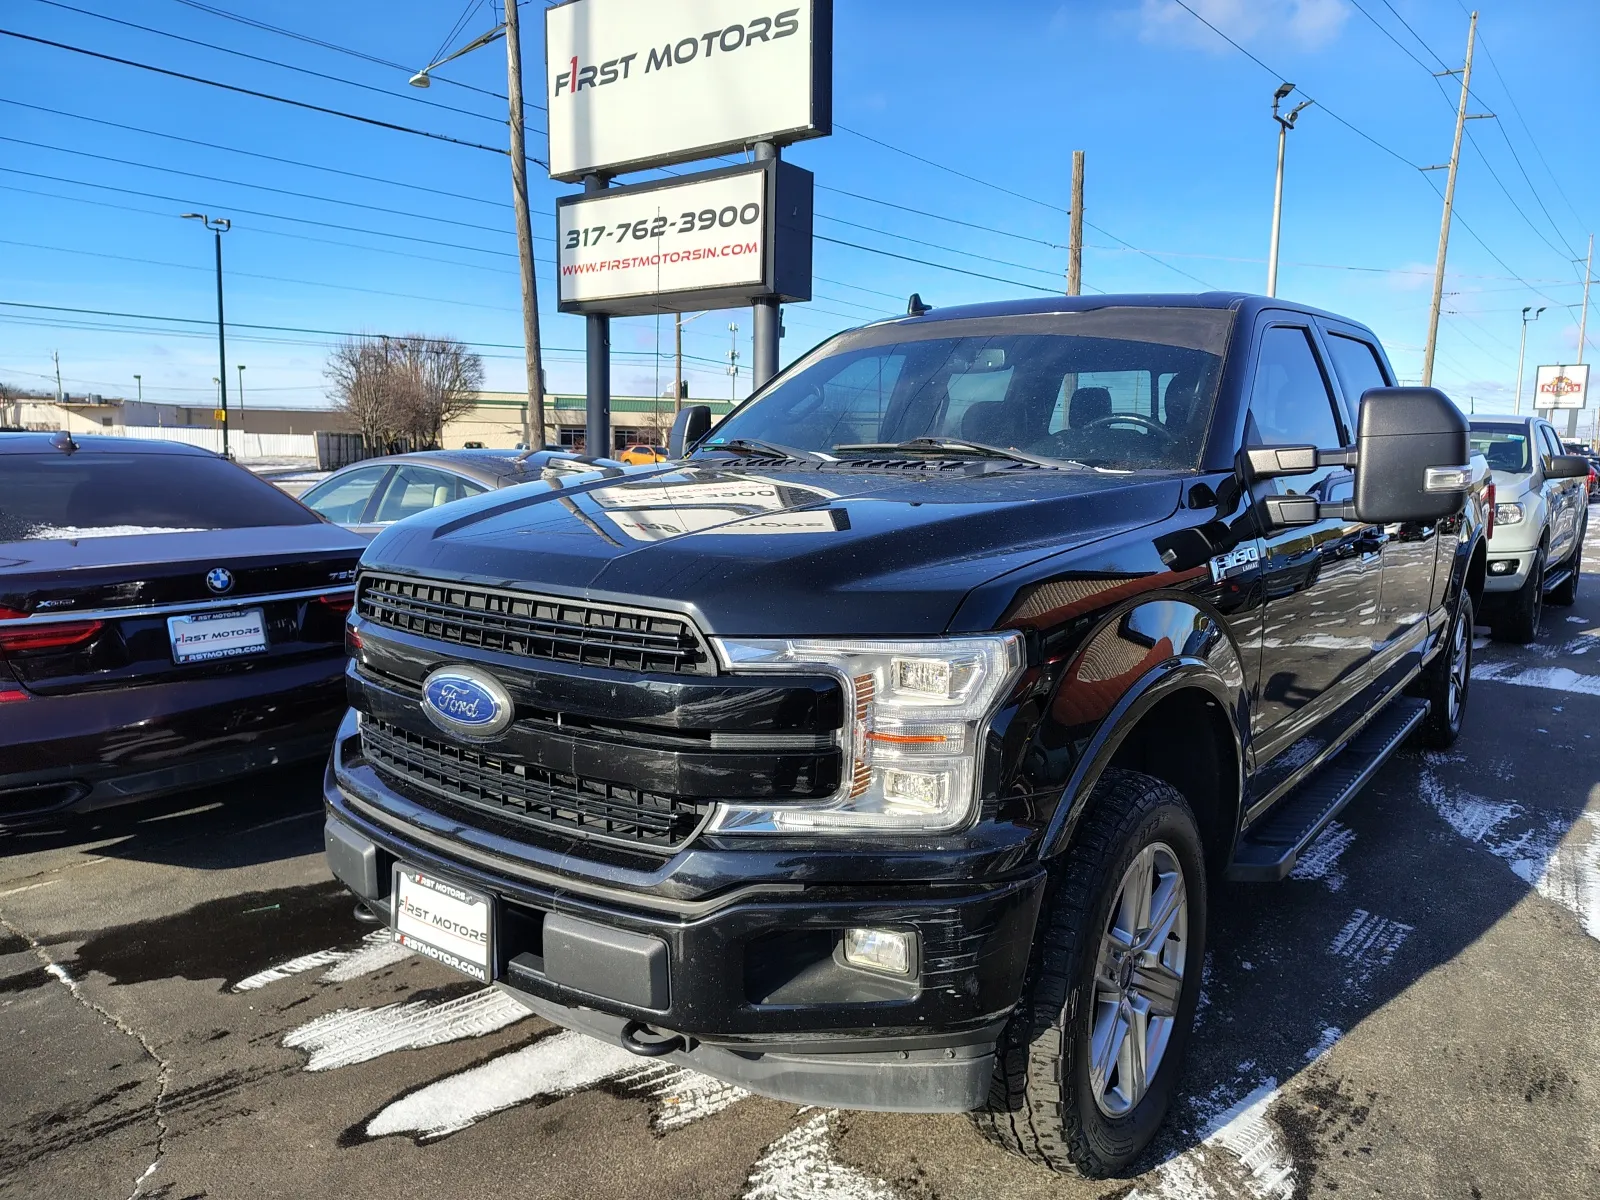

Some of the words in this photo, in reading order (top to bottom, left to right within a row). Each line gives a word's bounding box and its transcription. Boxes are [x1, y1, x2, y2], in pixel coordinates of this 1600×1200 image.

[644, 8, 800, 74] MOTORS
[565, 202, 760, 250] 317-762-3900
[562, 242, 758, 277] WWW.FIRSTMOTORSIN.COM
[212, 611, 241, 620] MOTORS
[212, 627, 260, 639] MOTORS
[438, 684, 480, 718] Ford
[435, 883, 466, 901] MOTORS
[432, 914, 487, 943] MOTORS
